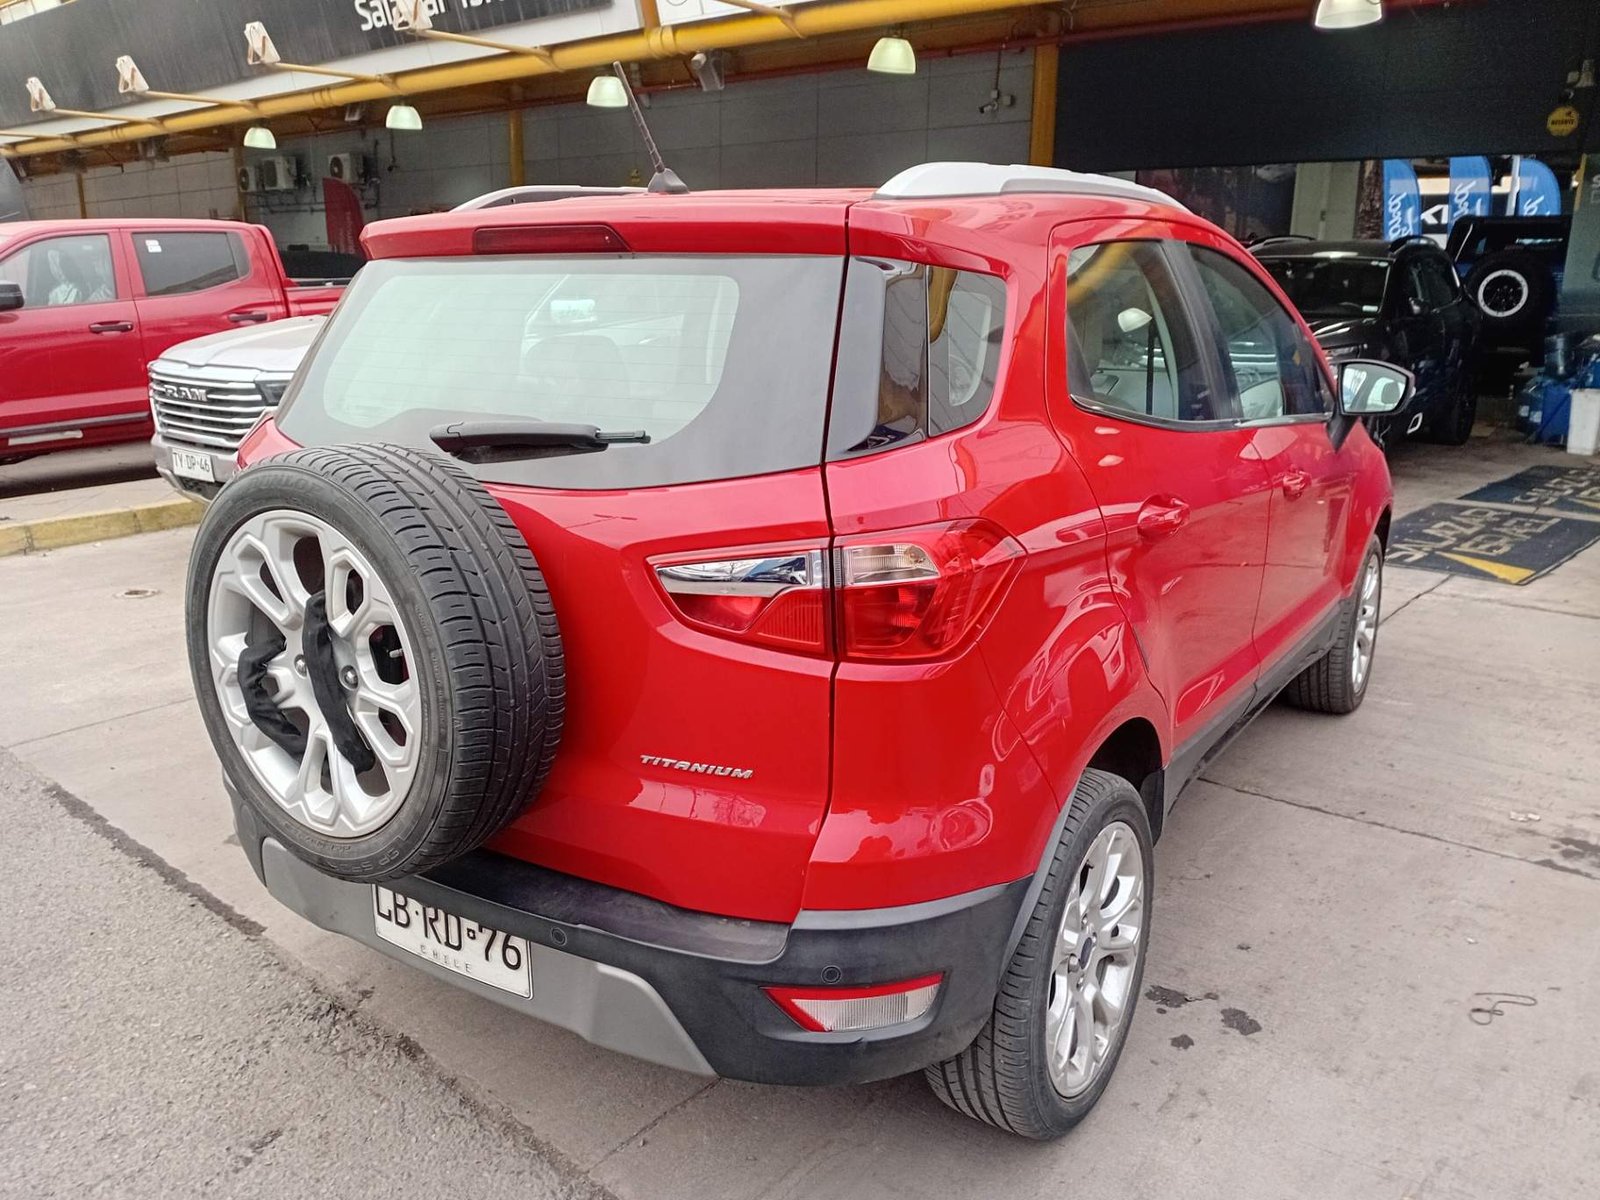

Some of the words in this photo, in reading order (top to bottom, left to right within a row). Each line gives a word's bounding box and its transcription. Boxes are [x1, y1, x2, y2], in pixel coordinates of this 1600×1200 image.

[355, 0, 446, 31] Sala
[163, 384, 208, 402] RAM
[640, 754, 754, 779] TITANIUM
[419, 944, 473, 974] CHILE
